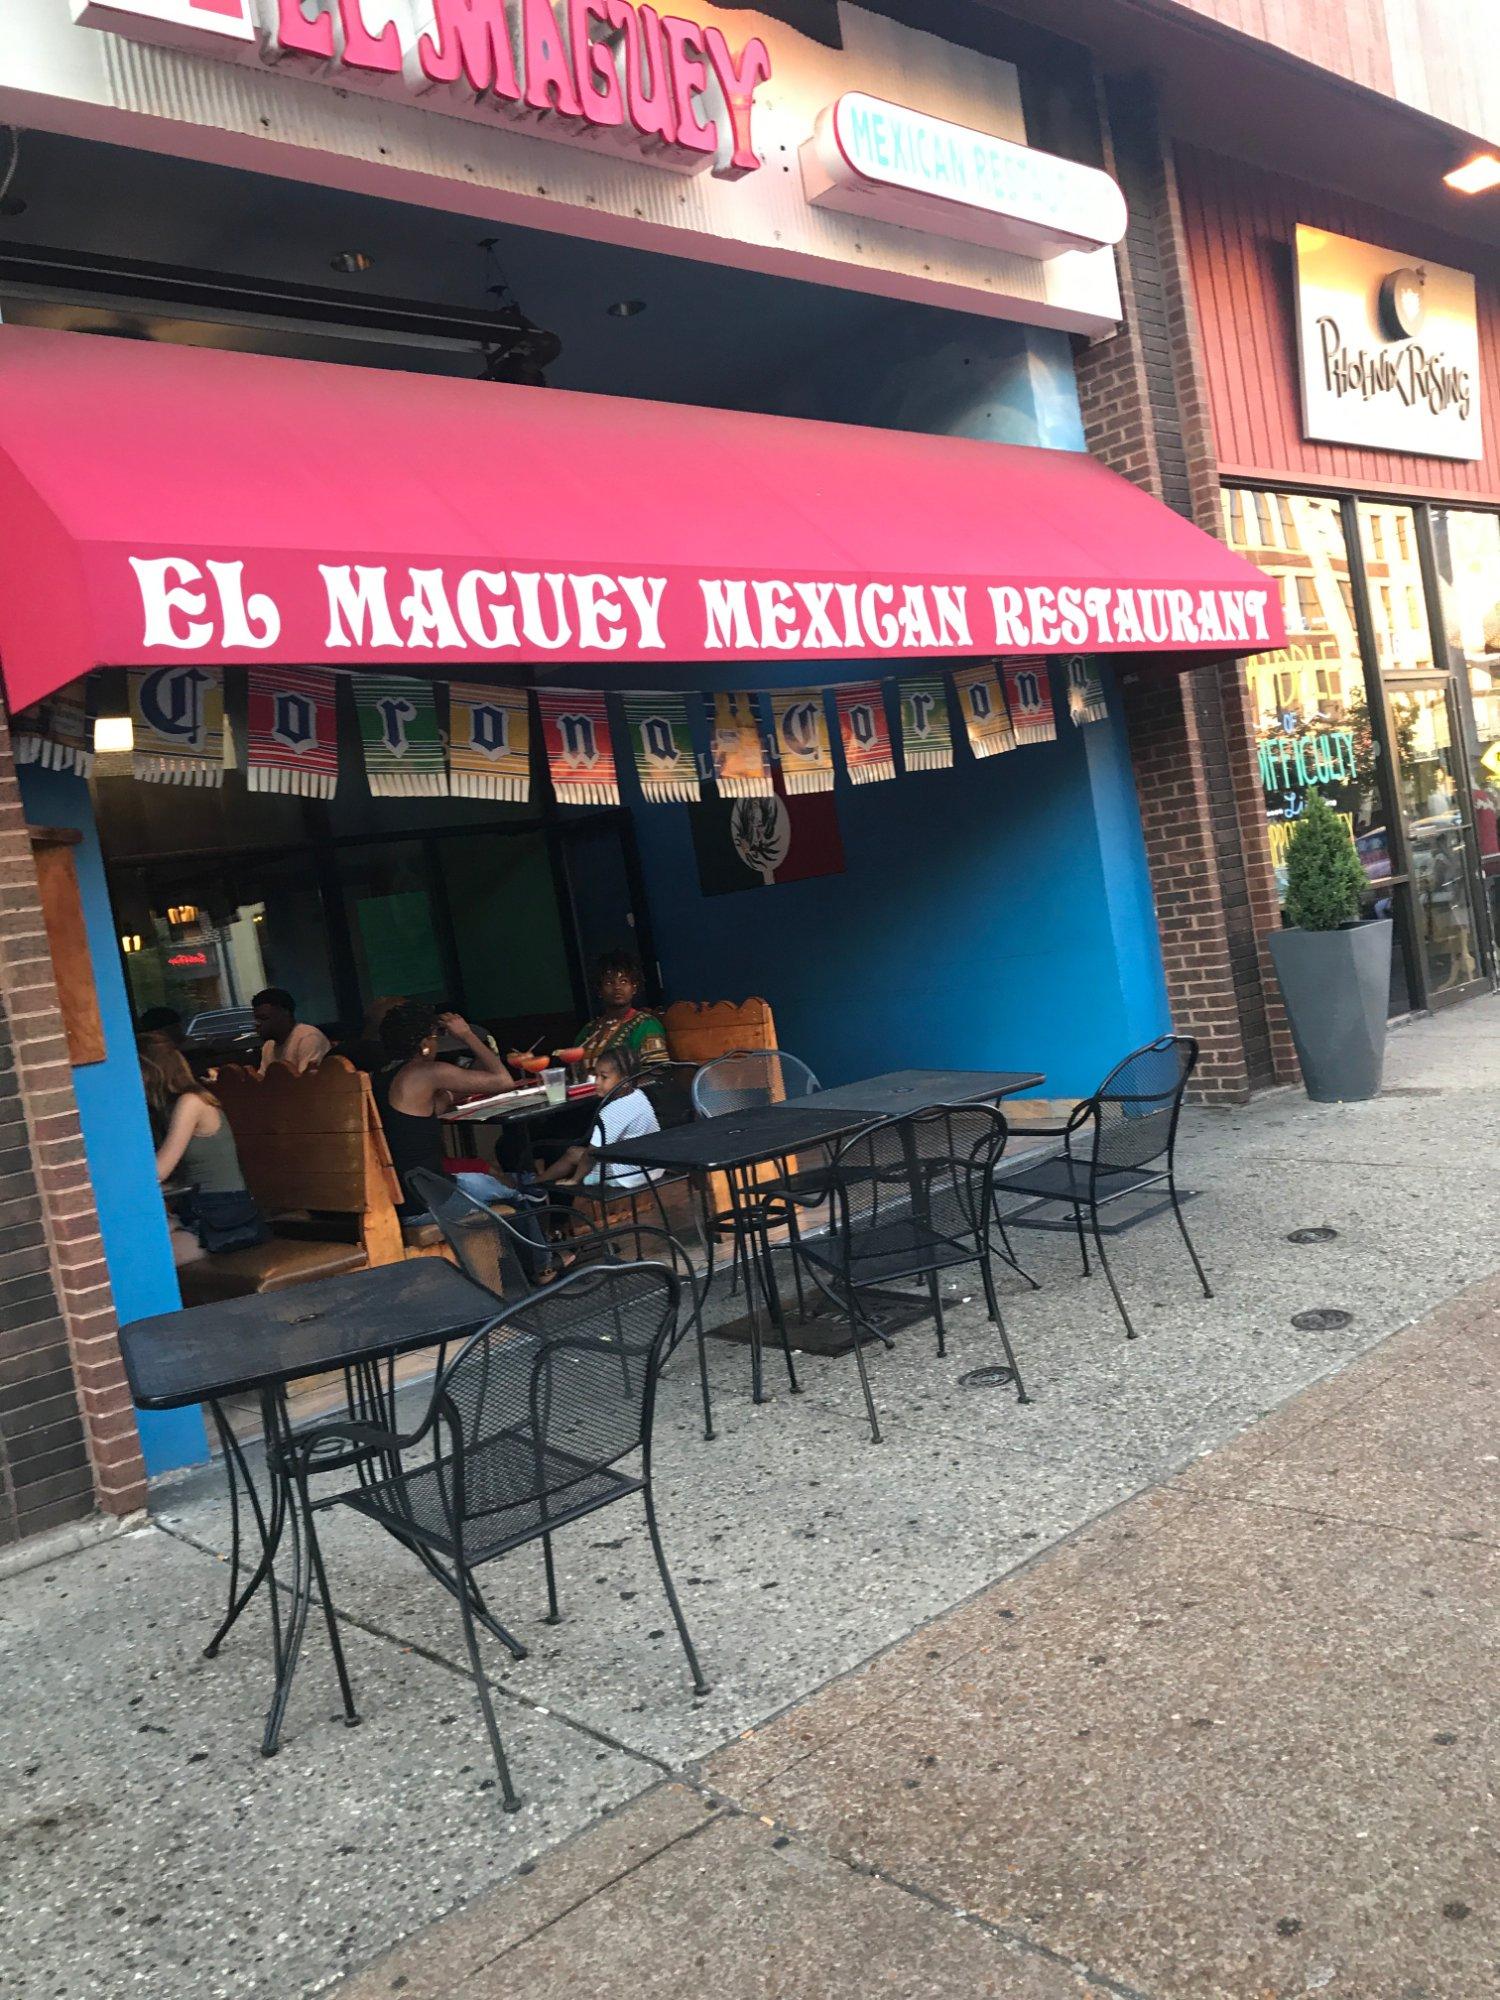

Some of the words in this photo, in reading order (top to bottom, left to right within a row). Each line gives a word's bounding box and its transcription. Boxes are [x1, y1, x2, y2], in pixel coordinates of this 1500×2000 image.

[419, 0, 772, 169] MAGUEY
[850, 105, 967, 187] MEXICAN
[1316, 315, 1411, 408] PHOENIX
[129, 556, 281, 649] EL
[318, 564, 667, 649] MAGUEY
[699, 579, 973, 649] MEXICAN
[987, 586, 1270, 647] RESTAURANT
[1283, 712, 1298, 734] OF
